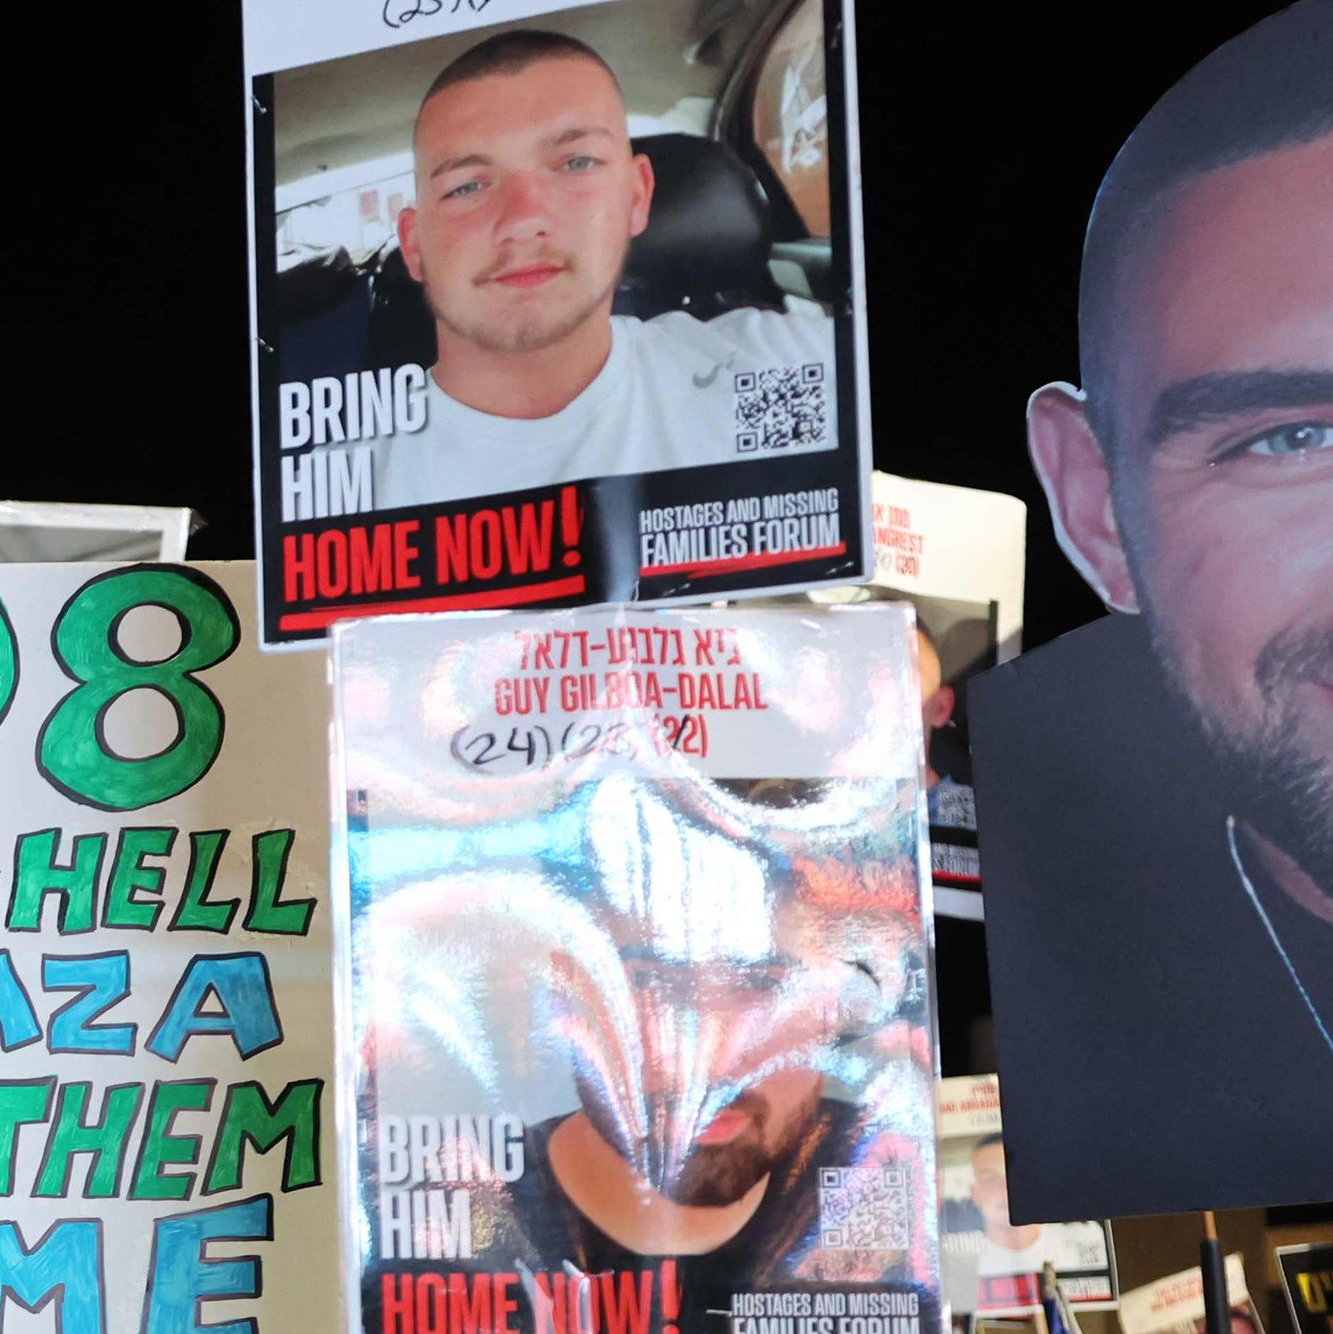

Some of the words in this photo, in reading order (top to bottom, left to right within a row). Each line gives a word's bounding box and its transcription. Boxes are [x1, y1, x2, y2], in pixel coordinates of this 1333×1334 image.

[280, 363, 428, 450] BRING
[280, 445, 373, 522] HIM
[640, 504, 723, 533] HOSTAGES
[727, 499, 757, 525] AND
[763, 488, 839, 517] MISSING
[280, 522, 421, 602] HOME
[436, 486, 583, 584] NOW!
[641, 528, 747, 570] FAMILIES
[752, 512, 841, 556] FORUM
[873, 528, 924, 555] NGREST
[693, 627, 741, 665] גיא
[494, 675, 550, 716] GUY
[7, 826, 319, 938] HELL
[380, 1114, 523, 1184] BRING
[380, 1190, 473, 1260] HIM
[732, 1294, 812, 1318] HOSTAGES
[815, 1293, 846, 1316] AND
[849, 1292, 918, 1316] MISSING
